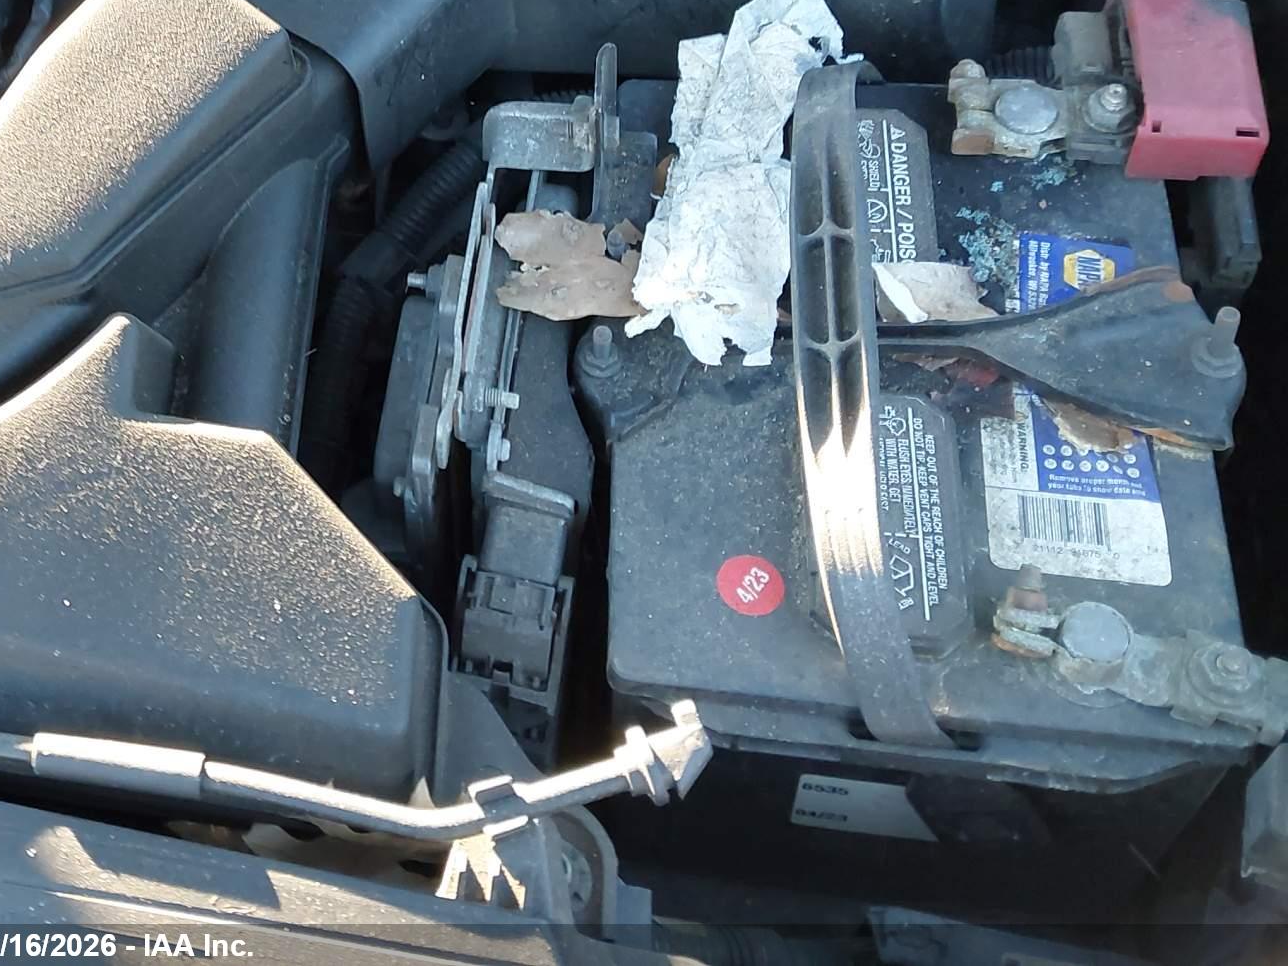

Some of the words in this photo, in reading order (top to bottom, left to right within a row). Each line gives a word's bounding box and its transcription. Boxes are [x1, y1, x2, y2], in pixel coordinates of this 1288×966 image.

[868, 160, 881, 188] SHIELD
[891, 142, 912, 206] DANGER
[896, 208, 913, 220] /
[913, 417, 923, 430] DO
[885, 438, 897, 457] WITH
[914, 431, 925, 448] NOT
[925, 434, 935, 454] KEEP
[898, 439, 910, 463] FLUSH
[916, 450, 926, 465] TIP.
[927, 456, 938, 472] OUT
[918, 466, 928, 487] KEEP
[928, 475, 938, 486] OF
[1049, 474, 1079, 483] Remove
[889, 487, 901, 503] GET
[919, 488, 930, 509] VENT
[929, 489, 940, 505] THE
[902, 485, 917, 534] IMMEDIATELY
[921, 511, 932, 533] CAPS
[931, 506, 943, 533] REACH
[888, 538, 911, 554] LEAD
[924, 535, 935, 559] TIGHT
[934, 535, 944, 549] OF
[926, 561, 937, 579] AND
[935, 549, 948, 590] CHILDREN
[736, 567, 770, 603] 4/23
[927, 581, 939, 606] LEVEL
